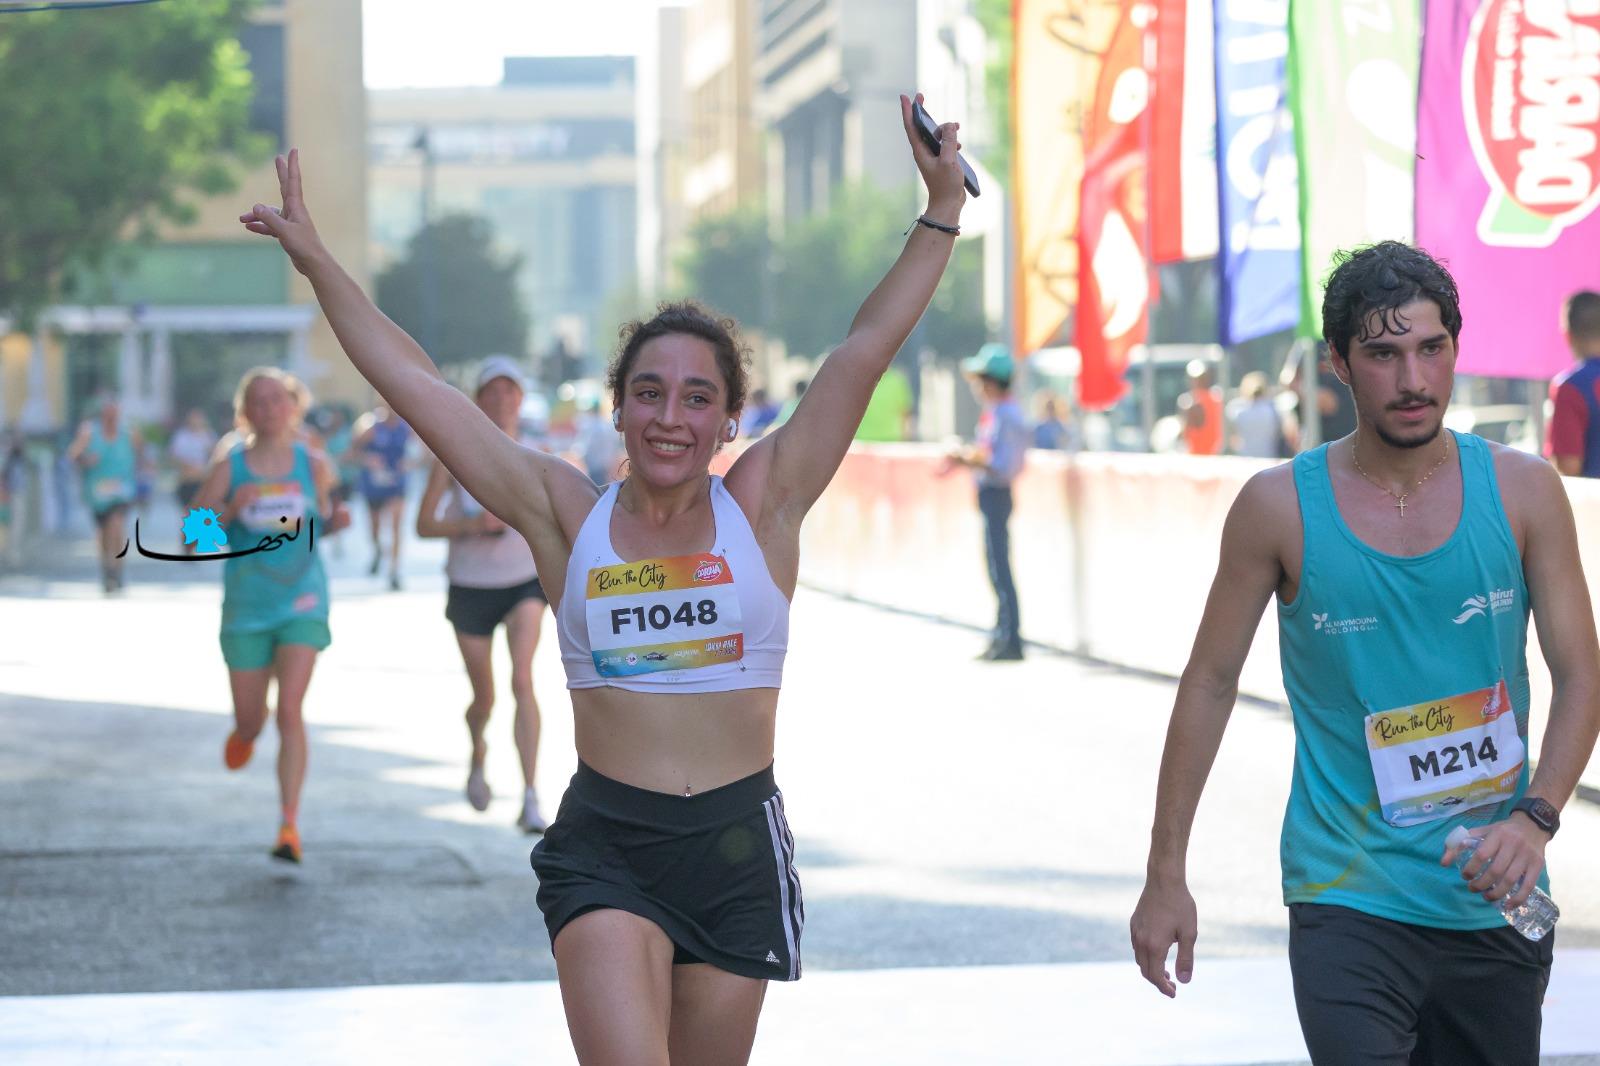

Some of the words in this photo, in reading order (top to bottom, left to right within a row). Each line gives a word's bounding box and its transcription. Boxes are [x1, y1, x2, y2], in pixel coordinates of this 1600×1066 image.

[595, 570, 622, 592] Run
[623, 569, 638, 584] the
[638, 563, 667, 590] City
[611, 600, 718, 634] F1048
[1324, 620, 1333, 629] AL
[1333, 616, 1379, 628] MAYMOUNA
[1324, 625, 1366, 636] HOLDING
[1375, 717, 1409, 741] Run
[1407, 714, 1424, 731] the
[1425, 705, 1455, 732] City
[1409, 736, 1498, 781] M214
